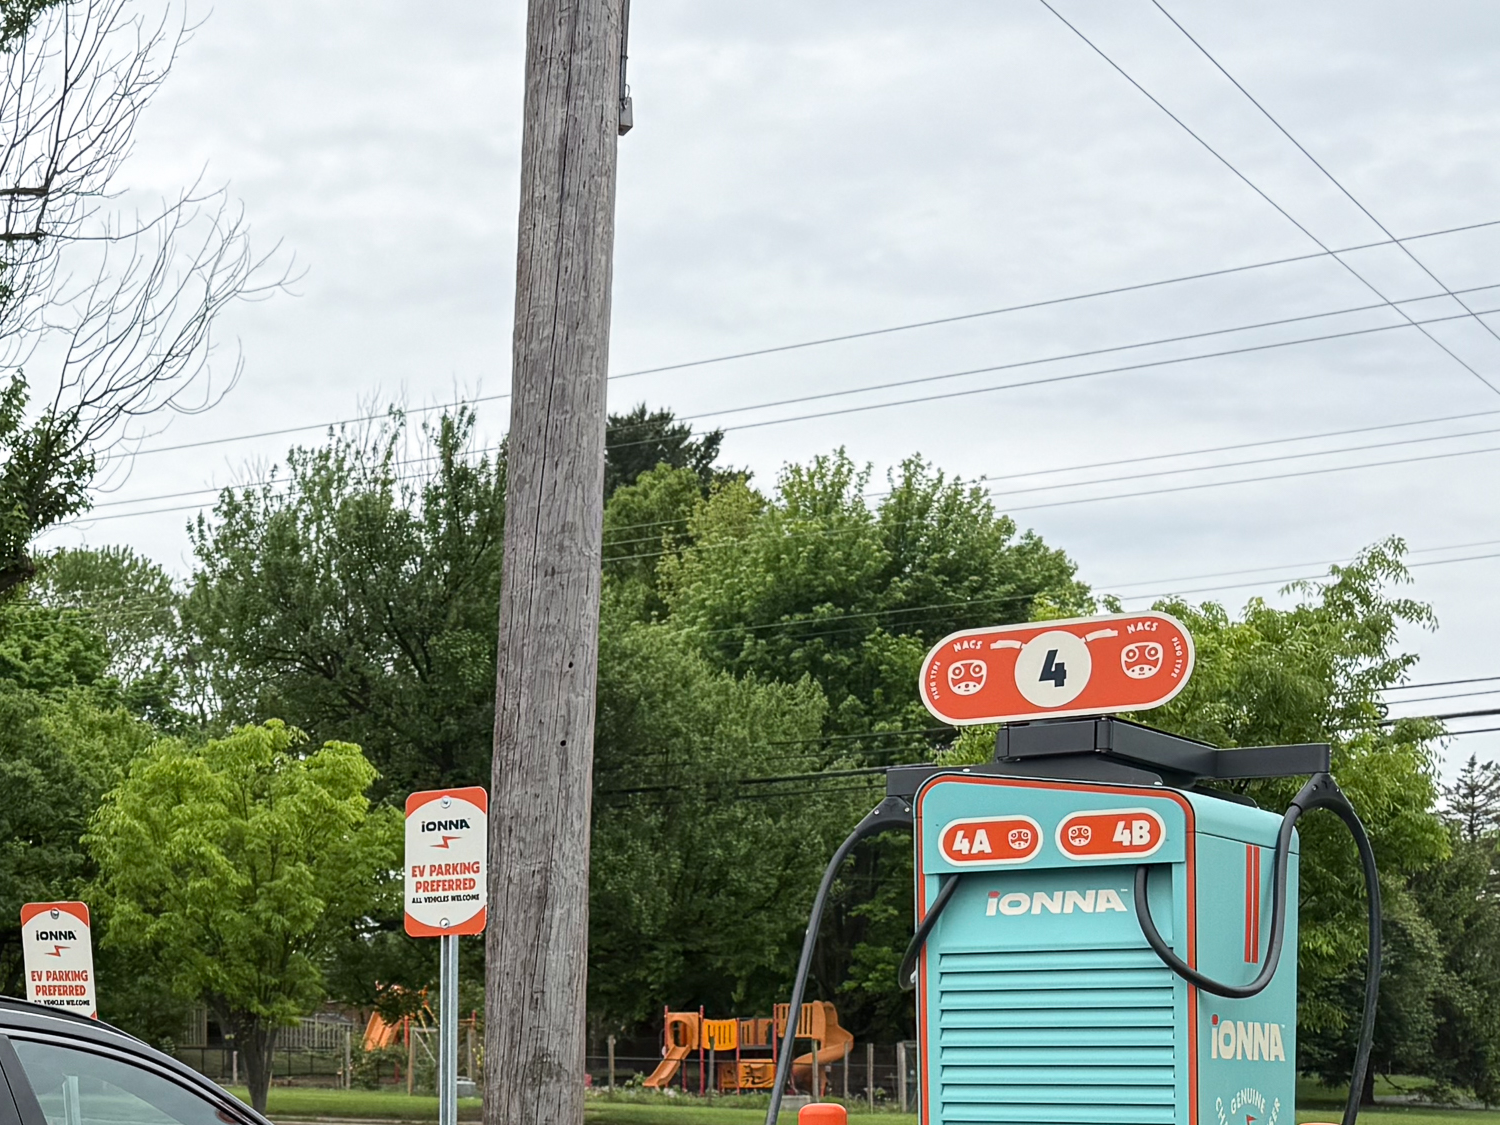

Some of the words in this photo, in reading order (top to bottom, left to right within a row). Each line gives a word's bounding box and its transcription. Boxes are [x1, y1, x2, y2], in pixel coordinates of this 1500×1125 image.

[1127, 621, 1158, 634] NACS
[953, 639, 983, 652] NACS
[1038, 649, 1067, 688] 4
[1170, 659, 1183, 678] TYPE
[1112, 819, 1151, 847] 4B
[951, 828, 993, 855] 4A
[411, 865, 426, 878] EV
[429, 861, 480, 877] PARKING
[415, 877, 476, 893] PREFERRED
[424, 895, 449, 904] VEHICLES
[451, 893, 480, 902] WELCOME
[31, 971, 43, 982] EV
[46, 970, 88, 981] PARKING
[35, 985, 86, 996] PREFERRED
[1230, 1087, 1266, 1115] GENUINE
